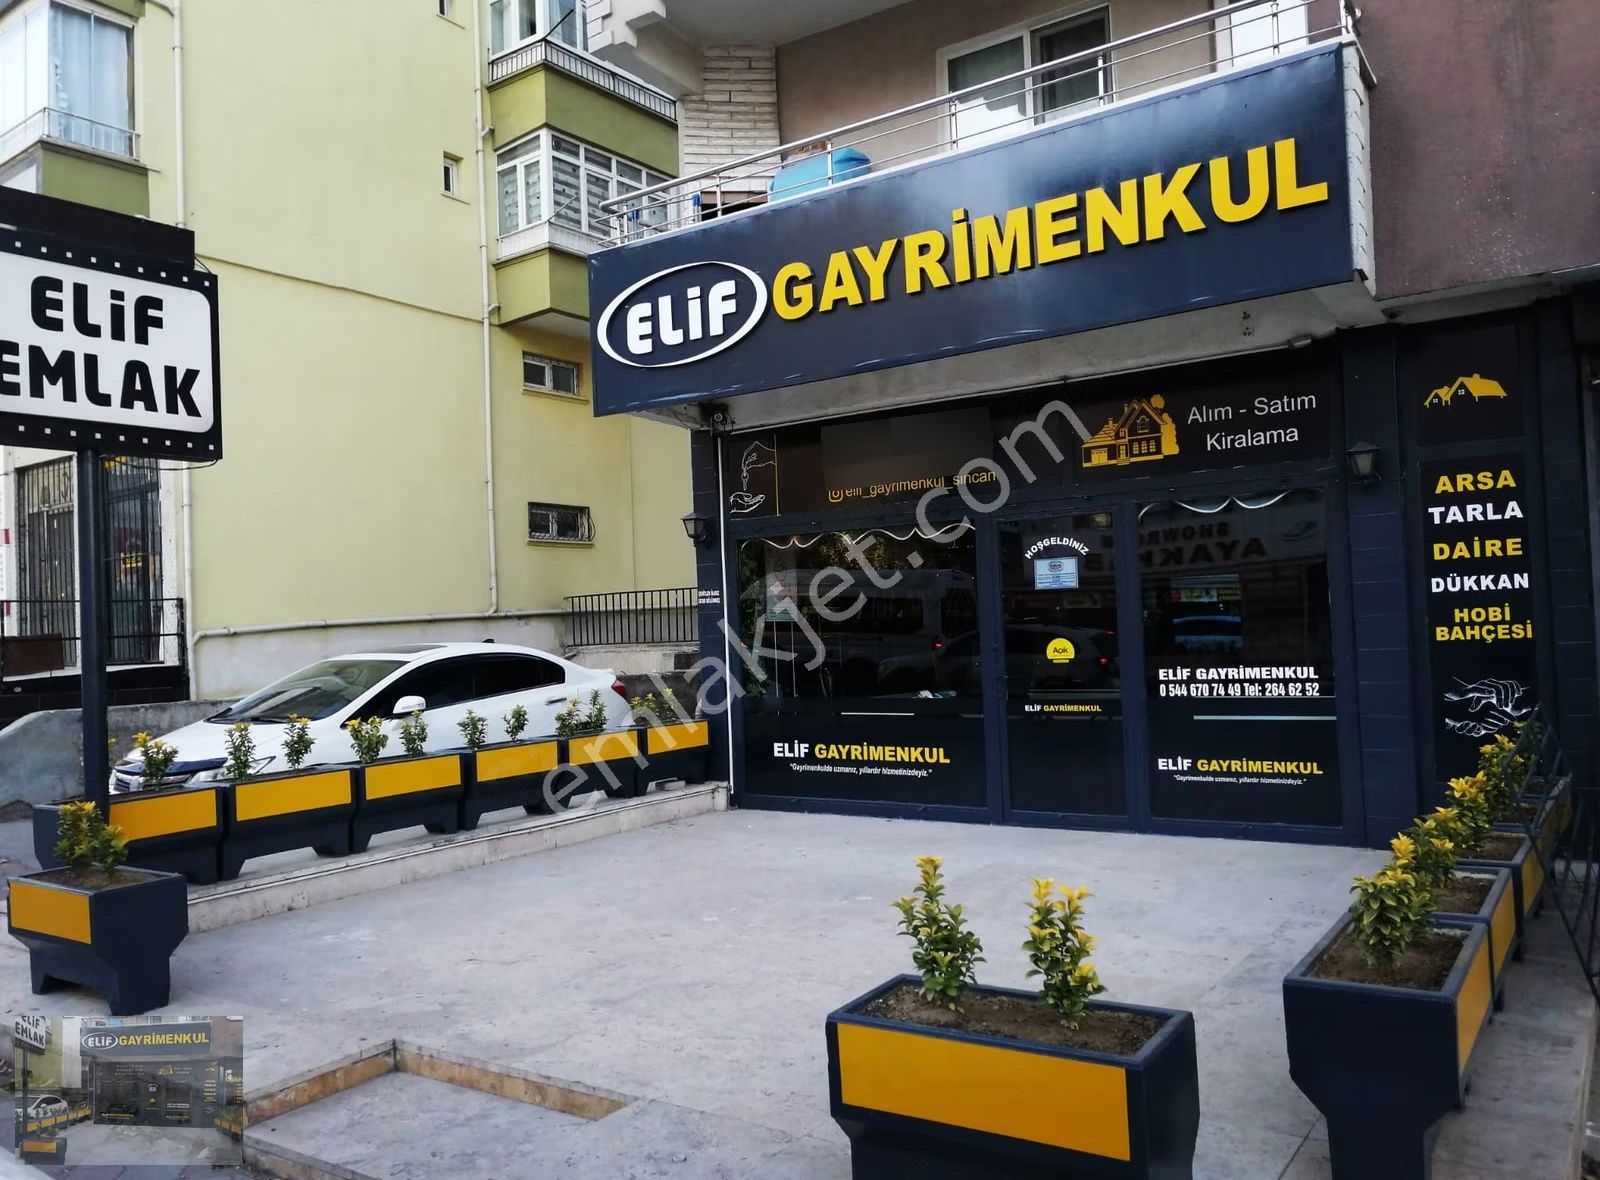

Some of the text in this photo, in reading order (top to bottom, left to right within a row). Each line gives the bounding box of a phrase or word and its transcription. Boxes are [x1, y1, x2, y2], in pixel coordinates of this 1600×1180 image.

[772, 137, 1329, 321] GAYRİMENKUL
[0, 339, 202, 418] EMLAK
[1187, 404, 1233, 425] Alım
[1254, 394, 1317, 416] Satım
[1206, 428, 1299, 452] Kiralama
[1435, 469, 1516, 494] ARSA
[1428, 500, 1524, 525] TARLA
[1024, 536, 1090, 559] HOŞGELDİNİZ
[1433, 536, 1522, 561] DAİRE
[1431, 572, 1529, 593] DÜKKAN
[1454, 602, 1511, 623] HOBİ
[1435, 619, 1533, 643] BAHÇESİ
[1053, 646, 1068, 655] Açık
[1158, 665, 1319, 681] ELİF GAYRİMENKUL
[1159, 683, 1320, 696] 0 544 670 74 49 Tel: 264 62 52
[1024, 703, 1102, 712] ELİF GAYRİMENKUL
[773, 740, 950, 764] ELİF GAYRİMENKUL
[1157, 756, 1323, 775] ELİF GAYRİMENKUL
